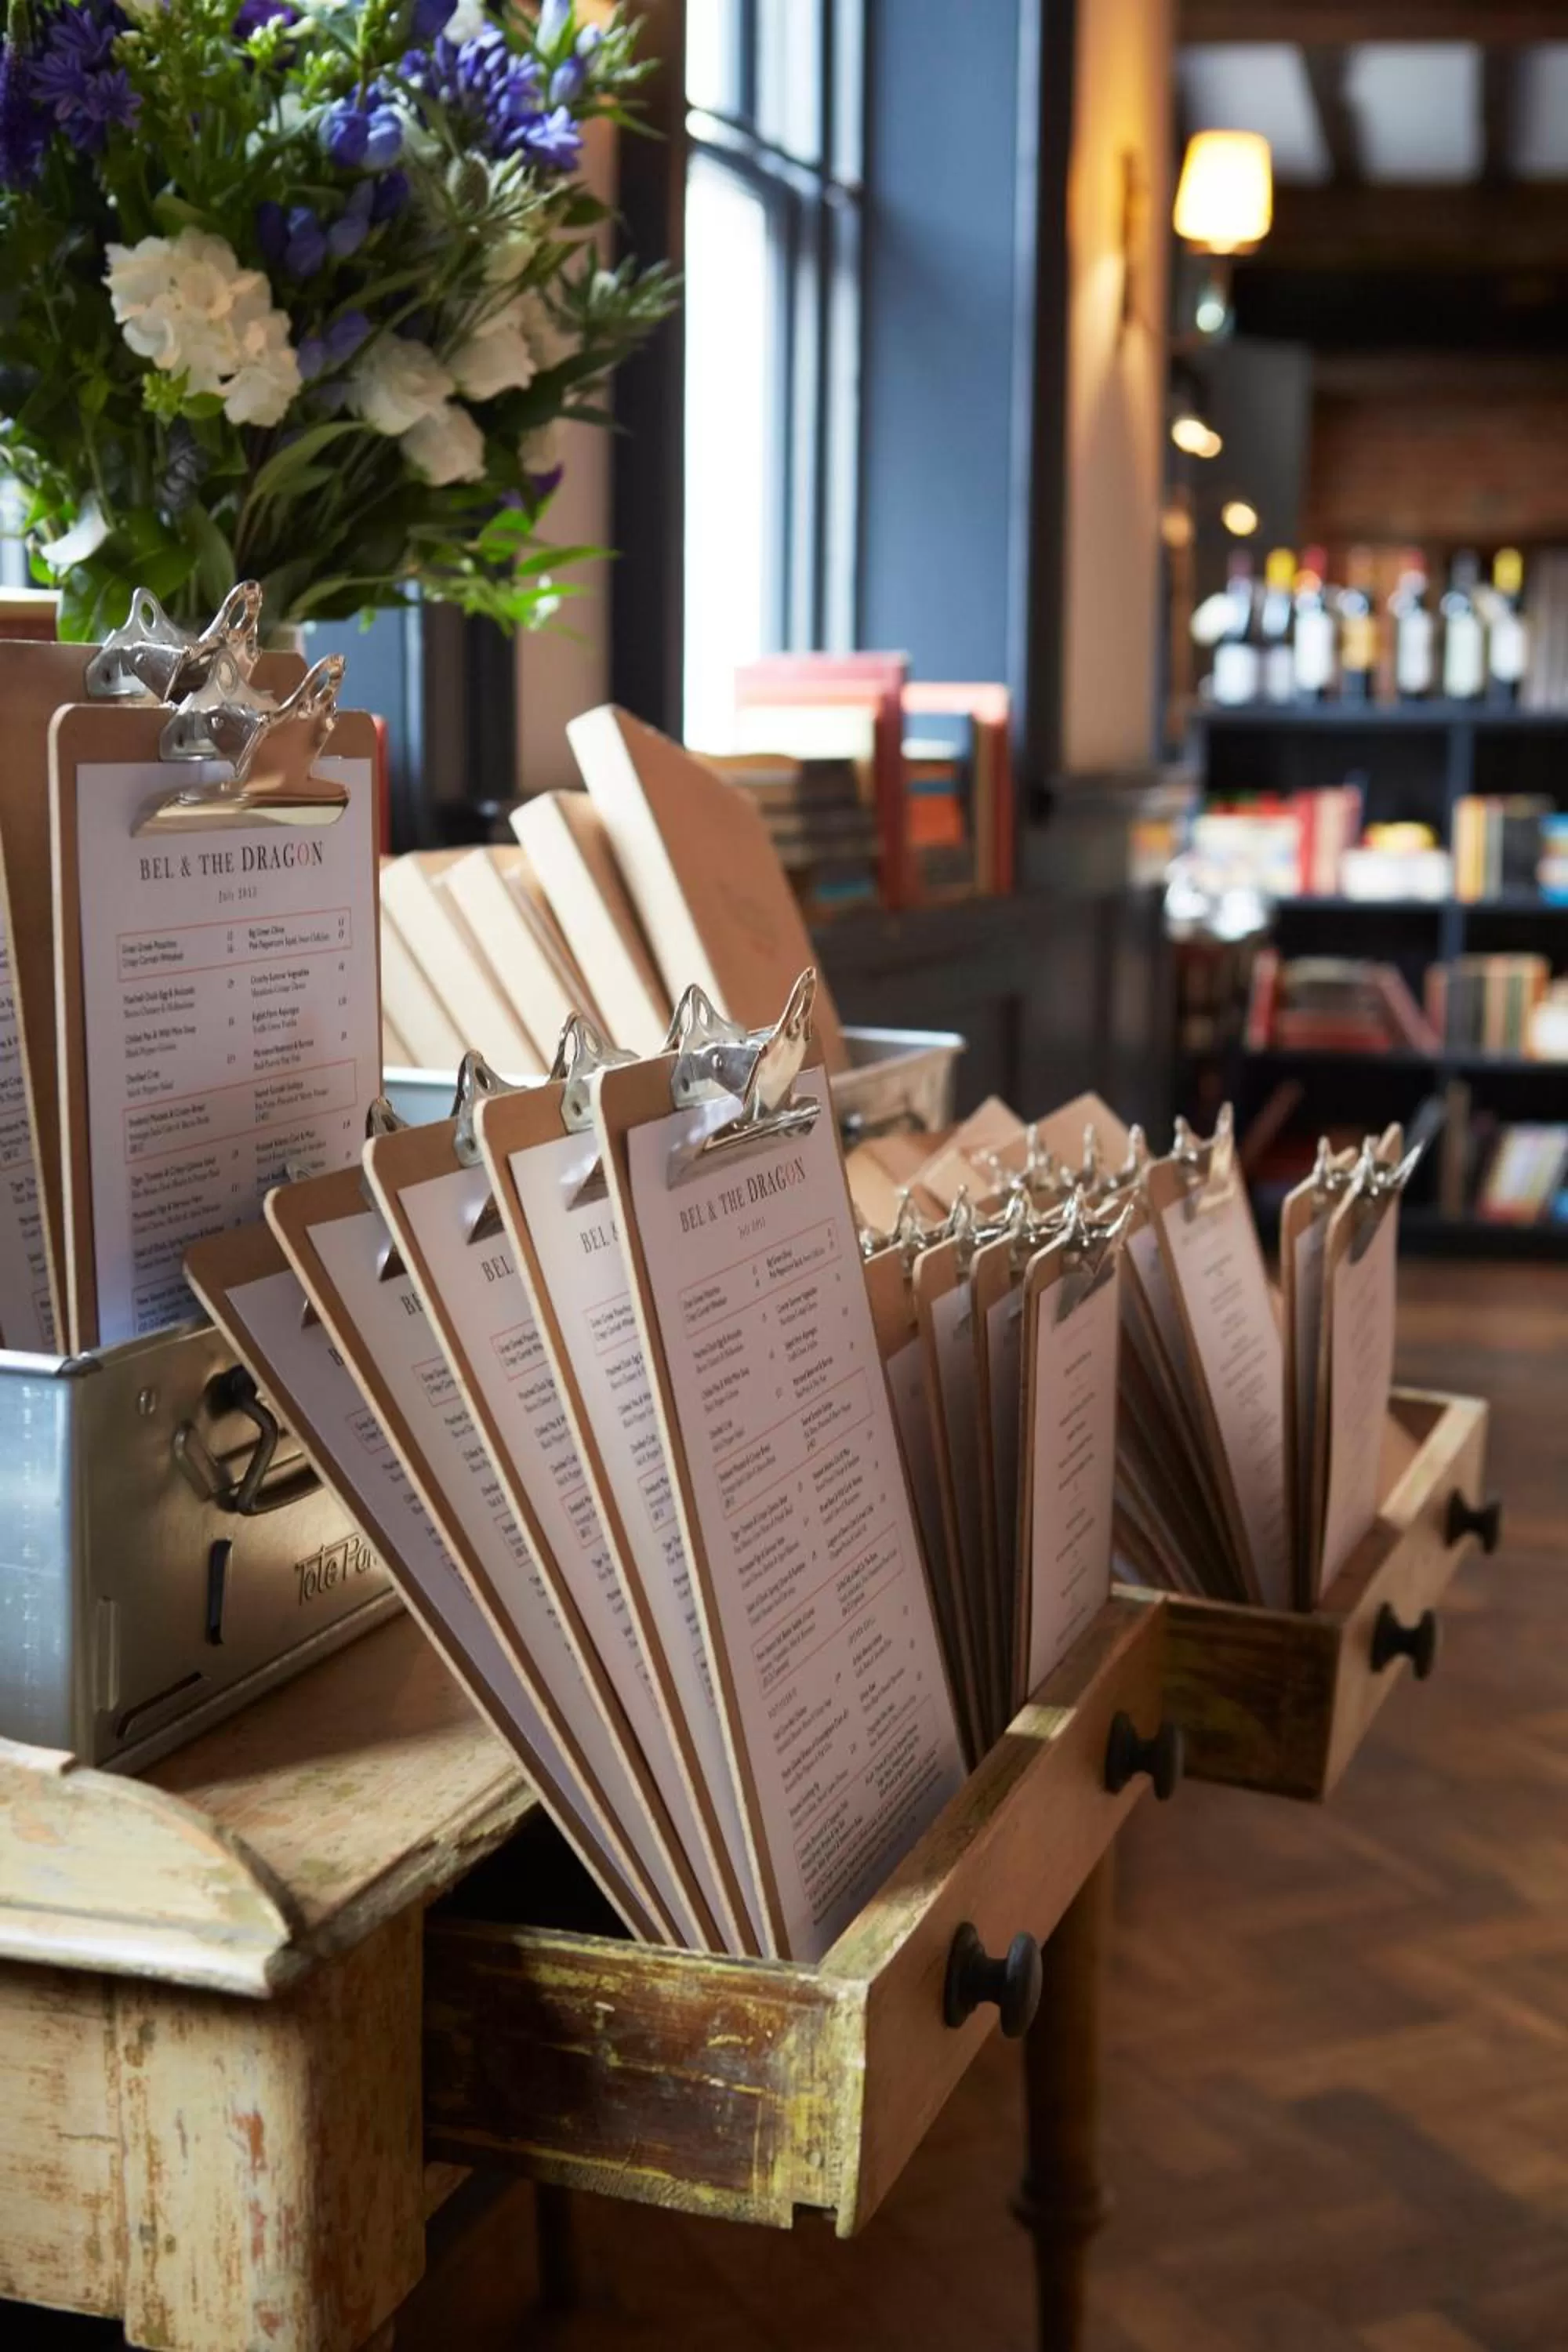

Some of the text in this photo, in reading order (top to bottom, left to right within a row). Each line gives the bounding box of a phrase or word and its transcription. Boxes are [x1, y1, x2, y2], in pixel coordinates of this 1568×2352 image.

[140, 840, 324, 880] BEL & THE DRAGON
[680, 1155, 806, 1233] BEL & THE DRAGON
[579, 1225, 611, 1254] BEL
[481, 1254, 514, 1282] BEL
